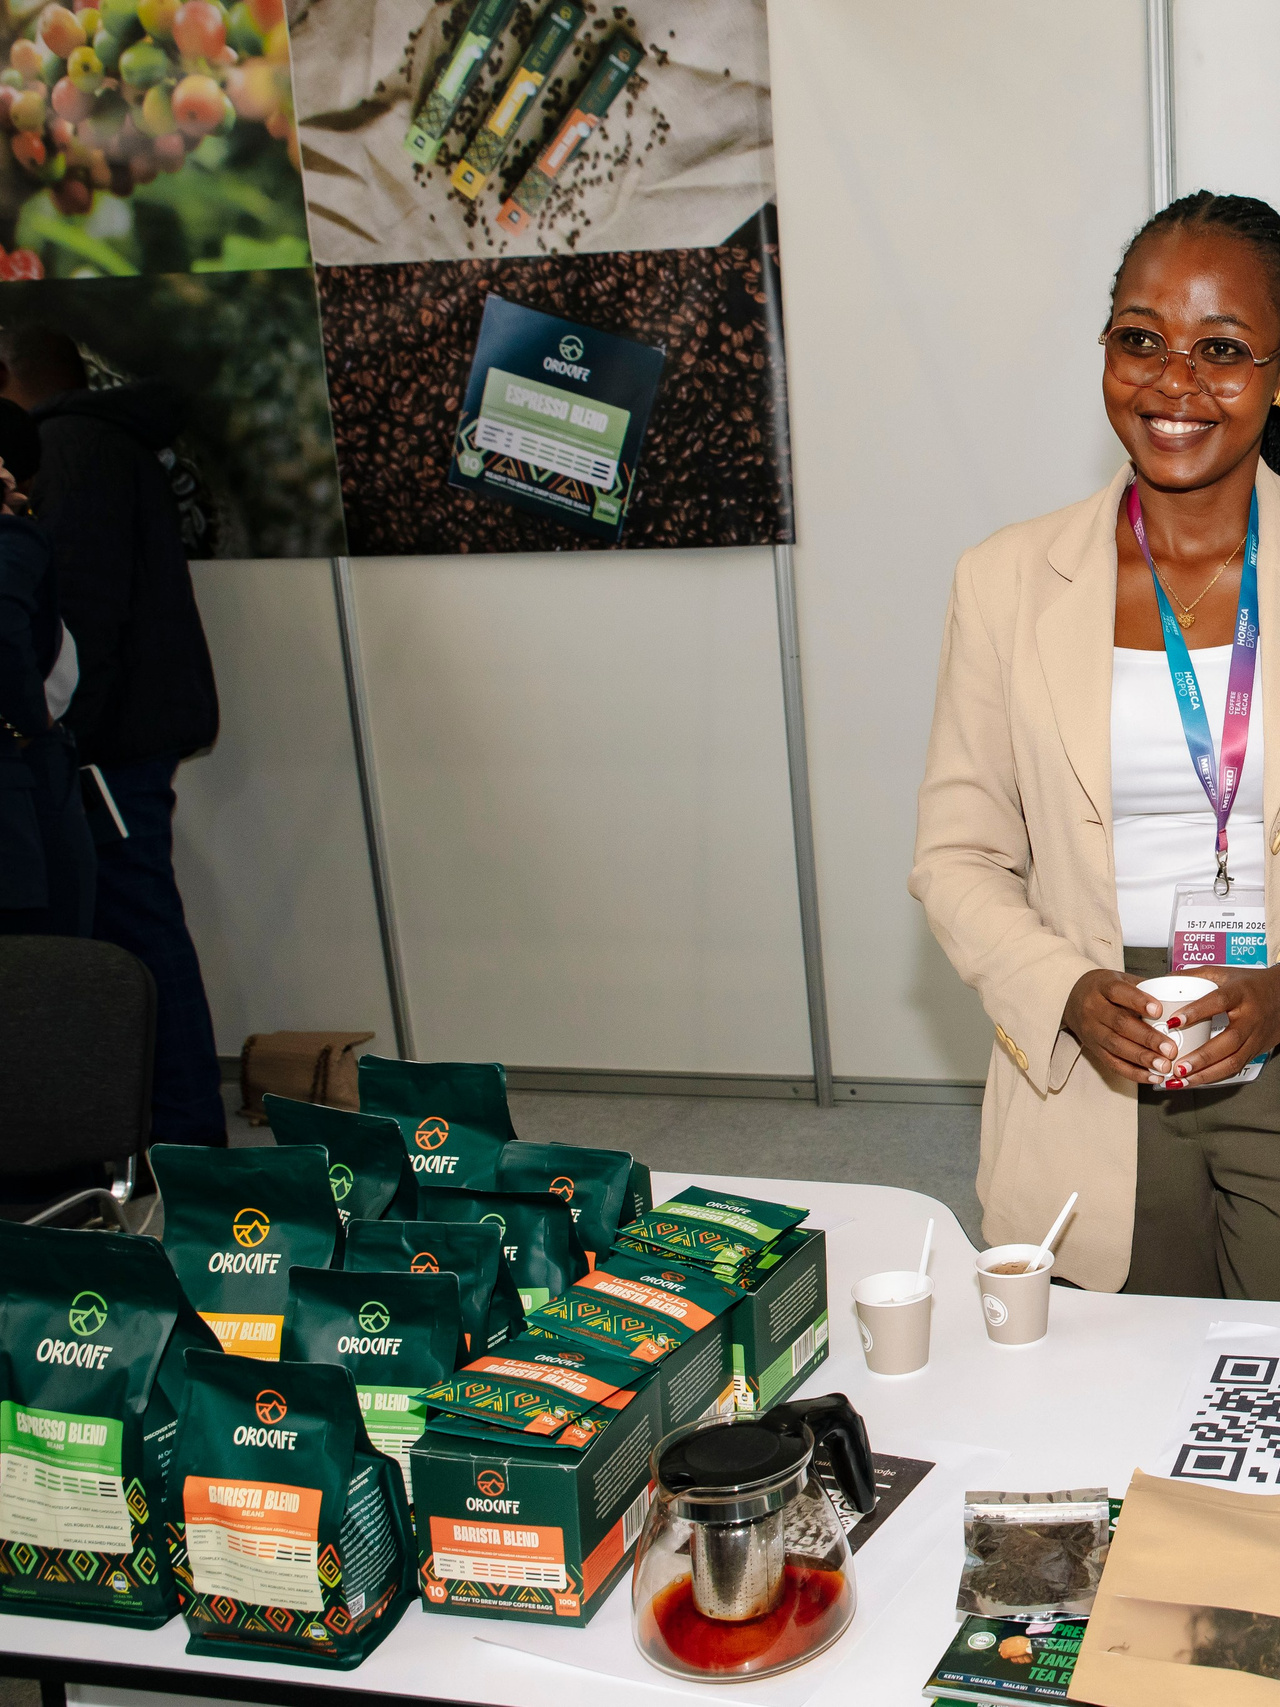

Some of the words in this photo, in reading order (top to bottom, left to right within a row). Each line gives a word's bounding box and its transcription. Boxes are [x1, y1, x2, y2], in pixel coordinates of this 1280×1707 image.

[505, 384, 569, 421] ESPRESSO
[569, 404, 608, 433] BLEND
[463, 453, 479, 470] 10
[1237, 608, 1249, 646] HORECA
[1246, 624, 1256, 649] EXPO
[1174, 671, 1188, 697] EXPO
[1184, 671, 1200, 711] HORECA
[1228, 691, 1236, 715] COFFEE
[1240, 693, 1249, 716] CACAO
[1223, 770, 1234, 809] METRO
[1187, 921, 1207, 929] 15-17
[1209, 921, 1243, 929] АПРЕЛЯ
[1246, 922, 1266, 930] 2026
[1183, 943, 1199, 951] TEA
[1184, 934, 1215, 942] COFFEE
[1183, 952, 1215, 961] CACAO
[1231, 946, 1256, 956] EXPO
[667, 1207, 725, 1223] ESPRESSO
[725, 1217, 759, 1235] BLEND
[593, 1281, 649, 1303] BARISTA
[649, 1298, 688, 1319] BLEND
[240, 1322, 276, 1342] BLEND
[646, 1342, 660, 1355] 10g
[483, 1364, 543, 1380] BARISTA
[544, 1371, 588, 1394] BLEND
[374, 1394, 410, 1412] BLEND
[16, 1412, 66, 1442] ESPRESSO
[68, 1422, 107, 1447] BLEND
[541, 1415, 556, 1426] 10g
[571, 1427, 587, 1439] 10g
[46, 1441, 65, 1451] BEANS
[208, 1485, 262, 1509] BARISTA
[264, 1490, 300, 1513] BLEND
[242, 1509, 265, 1518] BEANS
[453, 1525, 501, 1544] BARISTA
[503, 1530, 539, 1549] BLEND
[429, 1585, 445, 1597] 10
[451, 1595, 471, 1603] READY
[498, 1599, 513, 1607] DRIP
[513, 1601, 536, 1609] COFFEE
[536, 1603, 553, 1611] BAGS
[559, 1598, 576, 1607] 100g
[1028, 1667, 1057, 1683] TEA
[943, 1673, 964, 1682] KENYA
[970, 1677, 996, 1686] UGANDA
[1002, 1682, 1029, 1691] MALAWI
[1034, 1687, 1066, 1697] TANZANIA
